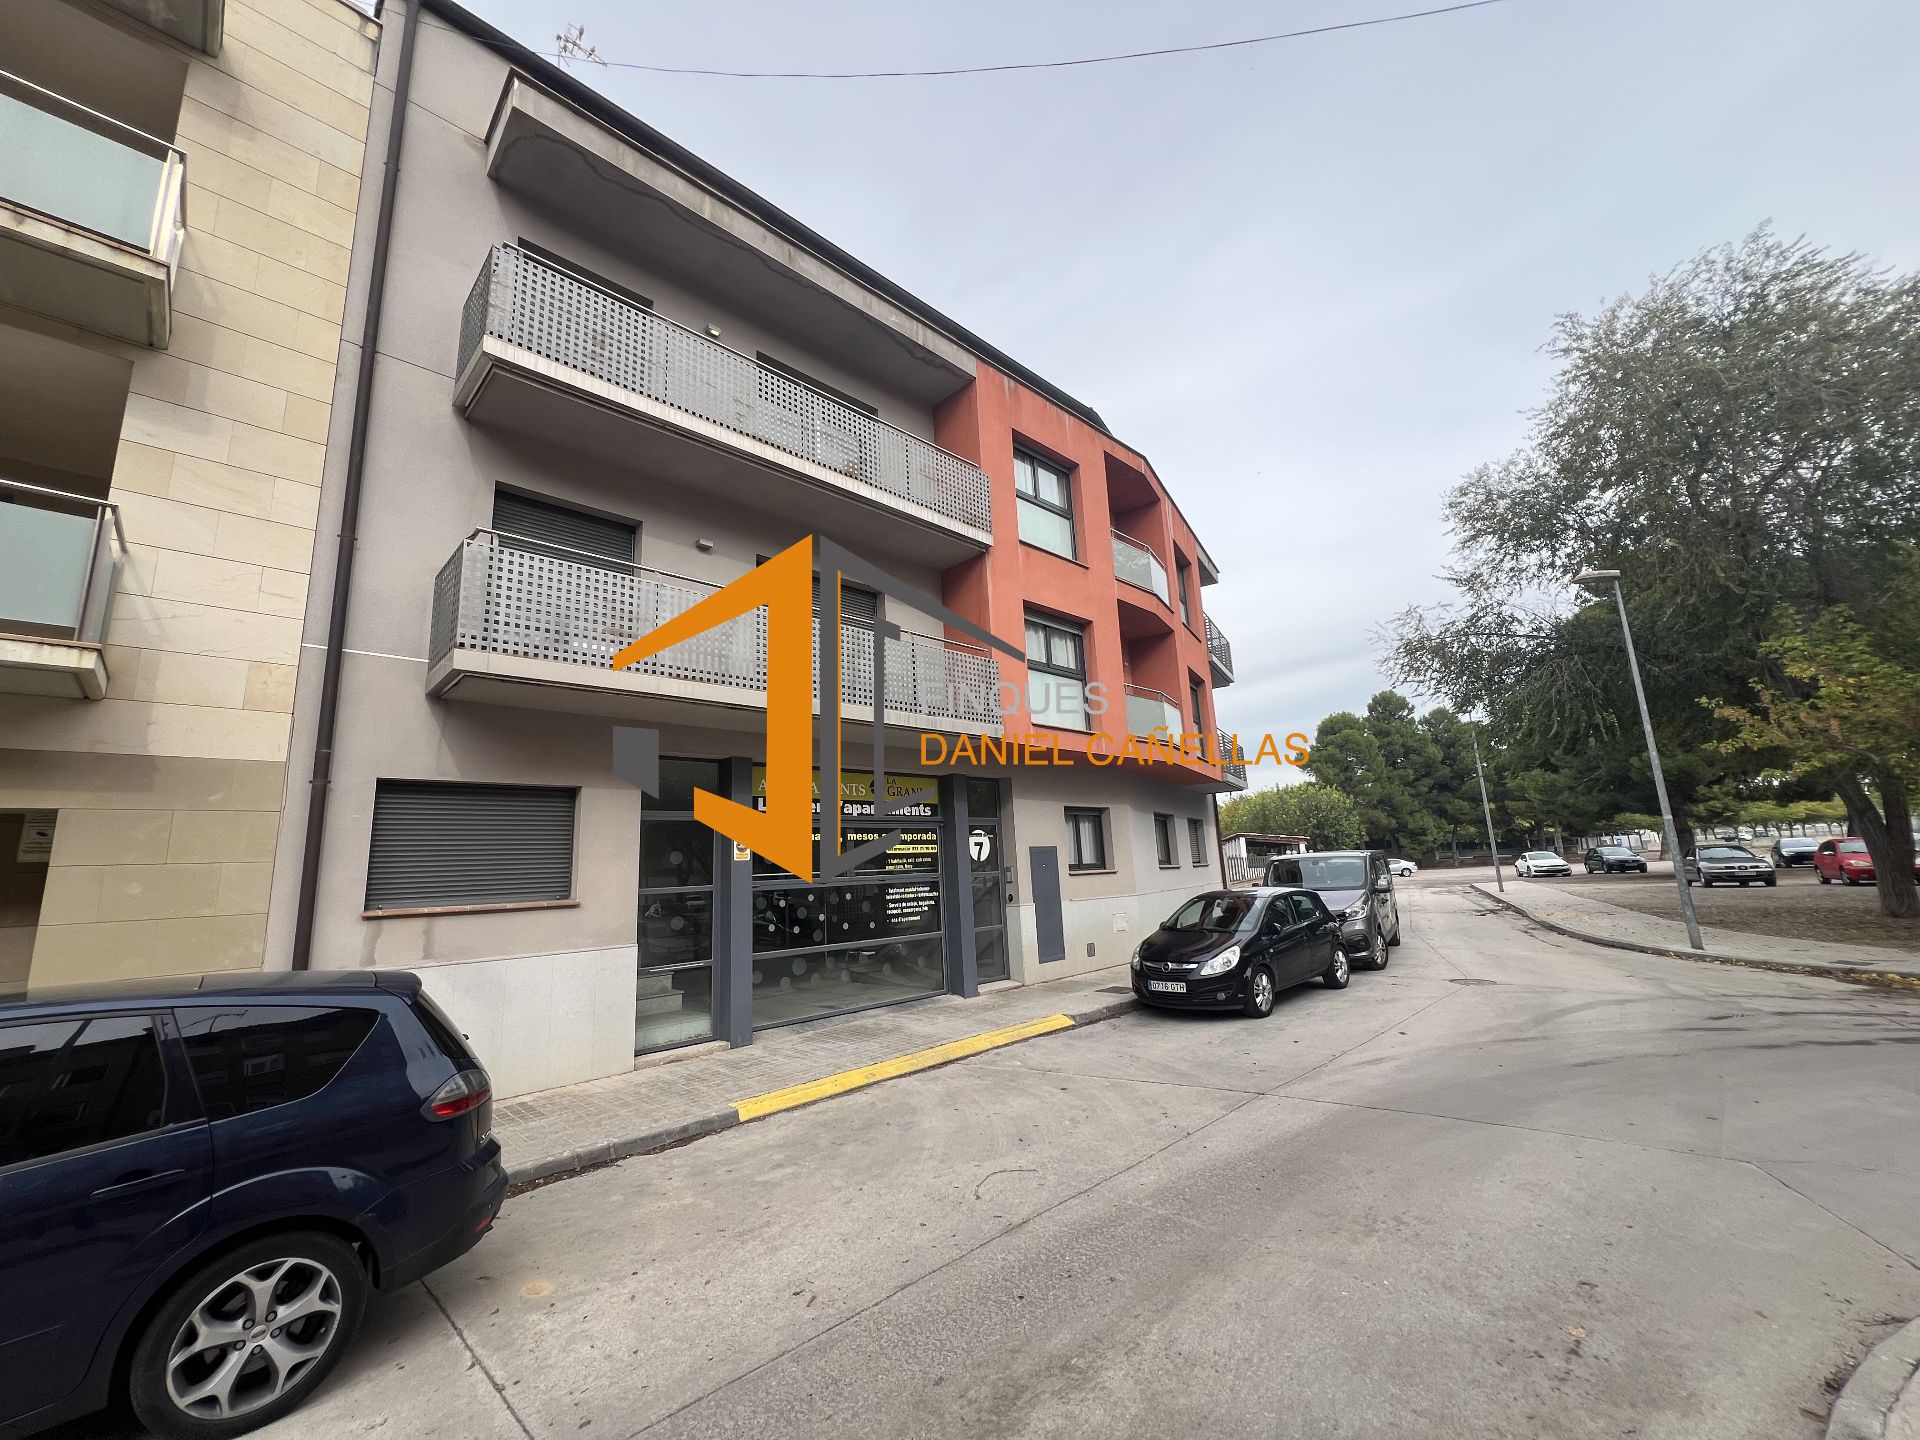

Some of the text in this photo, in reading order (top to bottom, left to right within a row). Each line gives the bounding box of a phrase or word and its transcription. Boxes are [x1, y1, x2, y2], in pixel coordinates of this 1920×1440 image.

[886, 777, 897, 785] LA
[847, 833, 879, 841] mesos
[900, 832, 937, 842] mporada
[973, 841, 984, 861] 7
[1171, 983, 1184, 991] GTH
